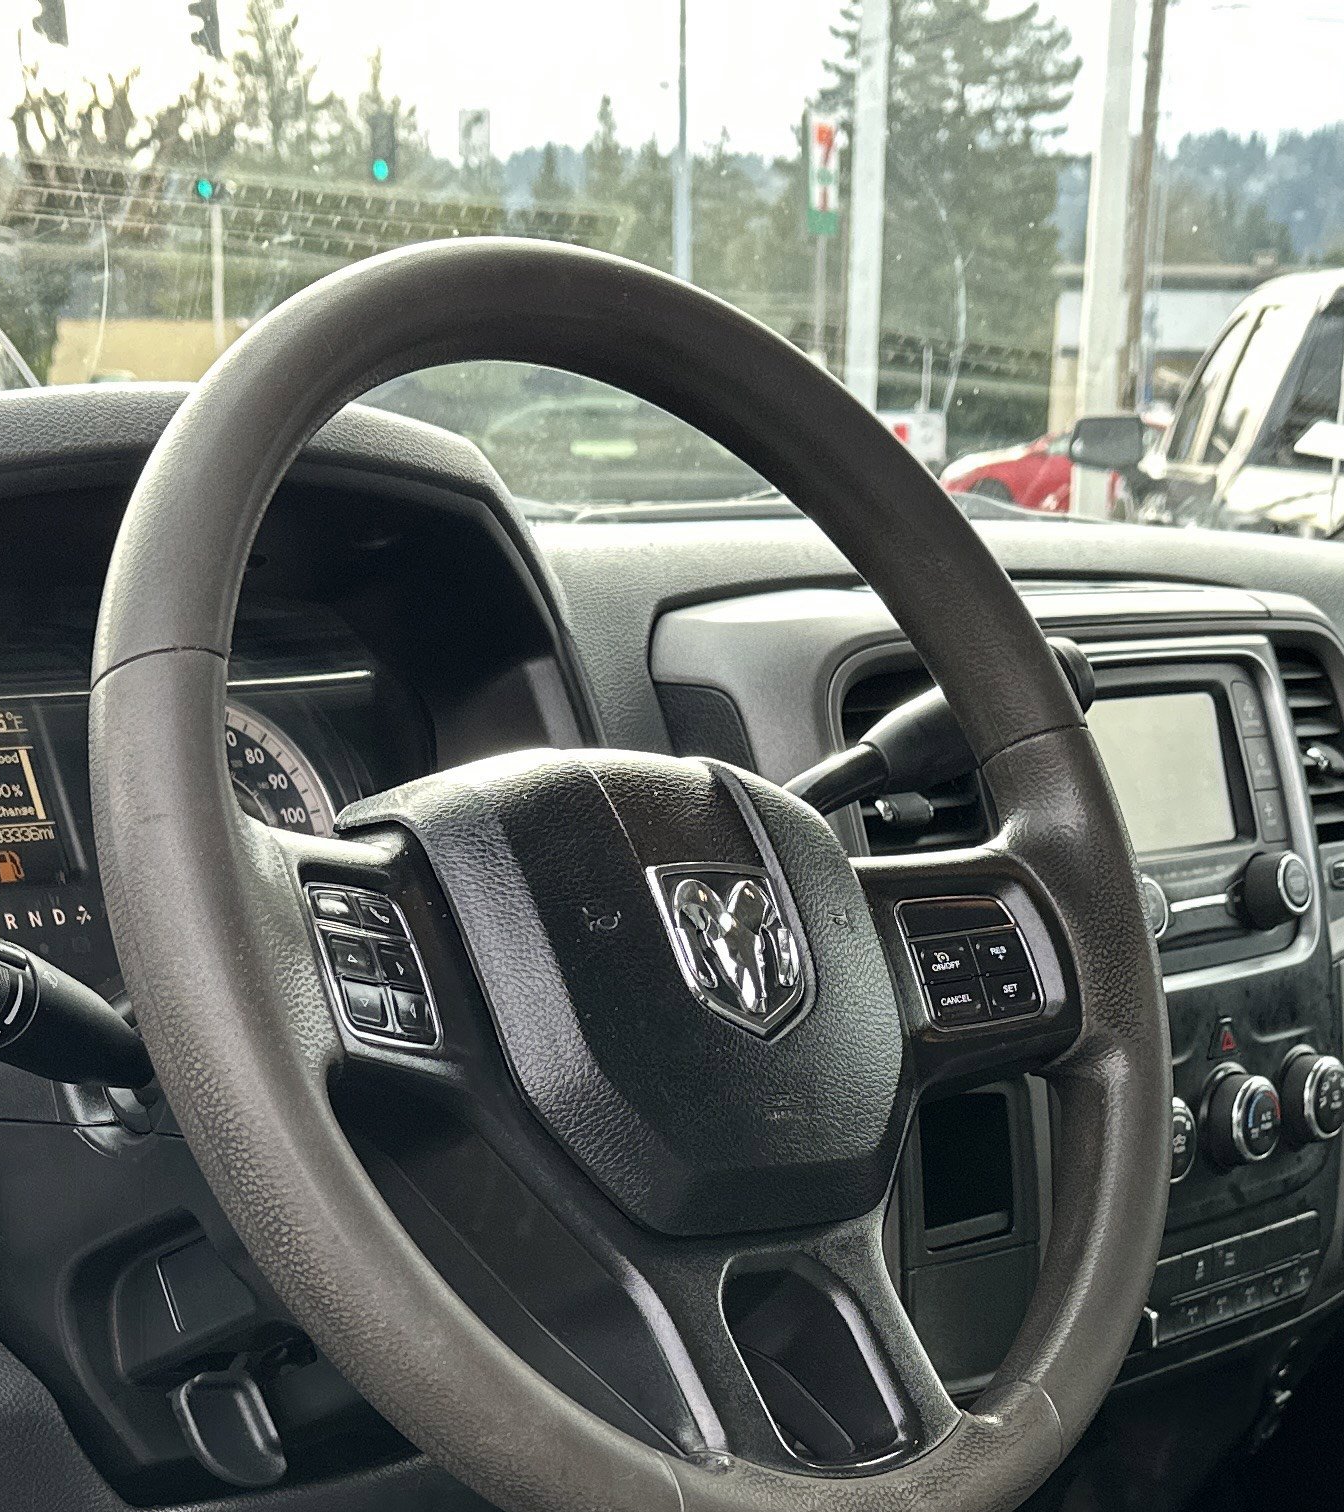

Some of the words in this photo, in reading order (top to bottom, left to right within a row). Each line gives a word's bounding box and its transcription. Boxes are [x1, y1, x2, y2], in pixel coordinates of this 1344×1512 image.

[244, 748, 265, 764] 80
[268, 773, 288, 790] 90
[280, 807, 306, 824] 100
[4, 913, 18, 930] R
[27, 911, 43, 928] N
[52, 908, 66, 925] D
[940, 994, 972, 1006] CANCEL
